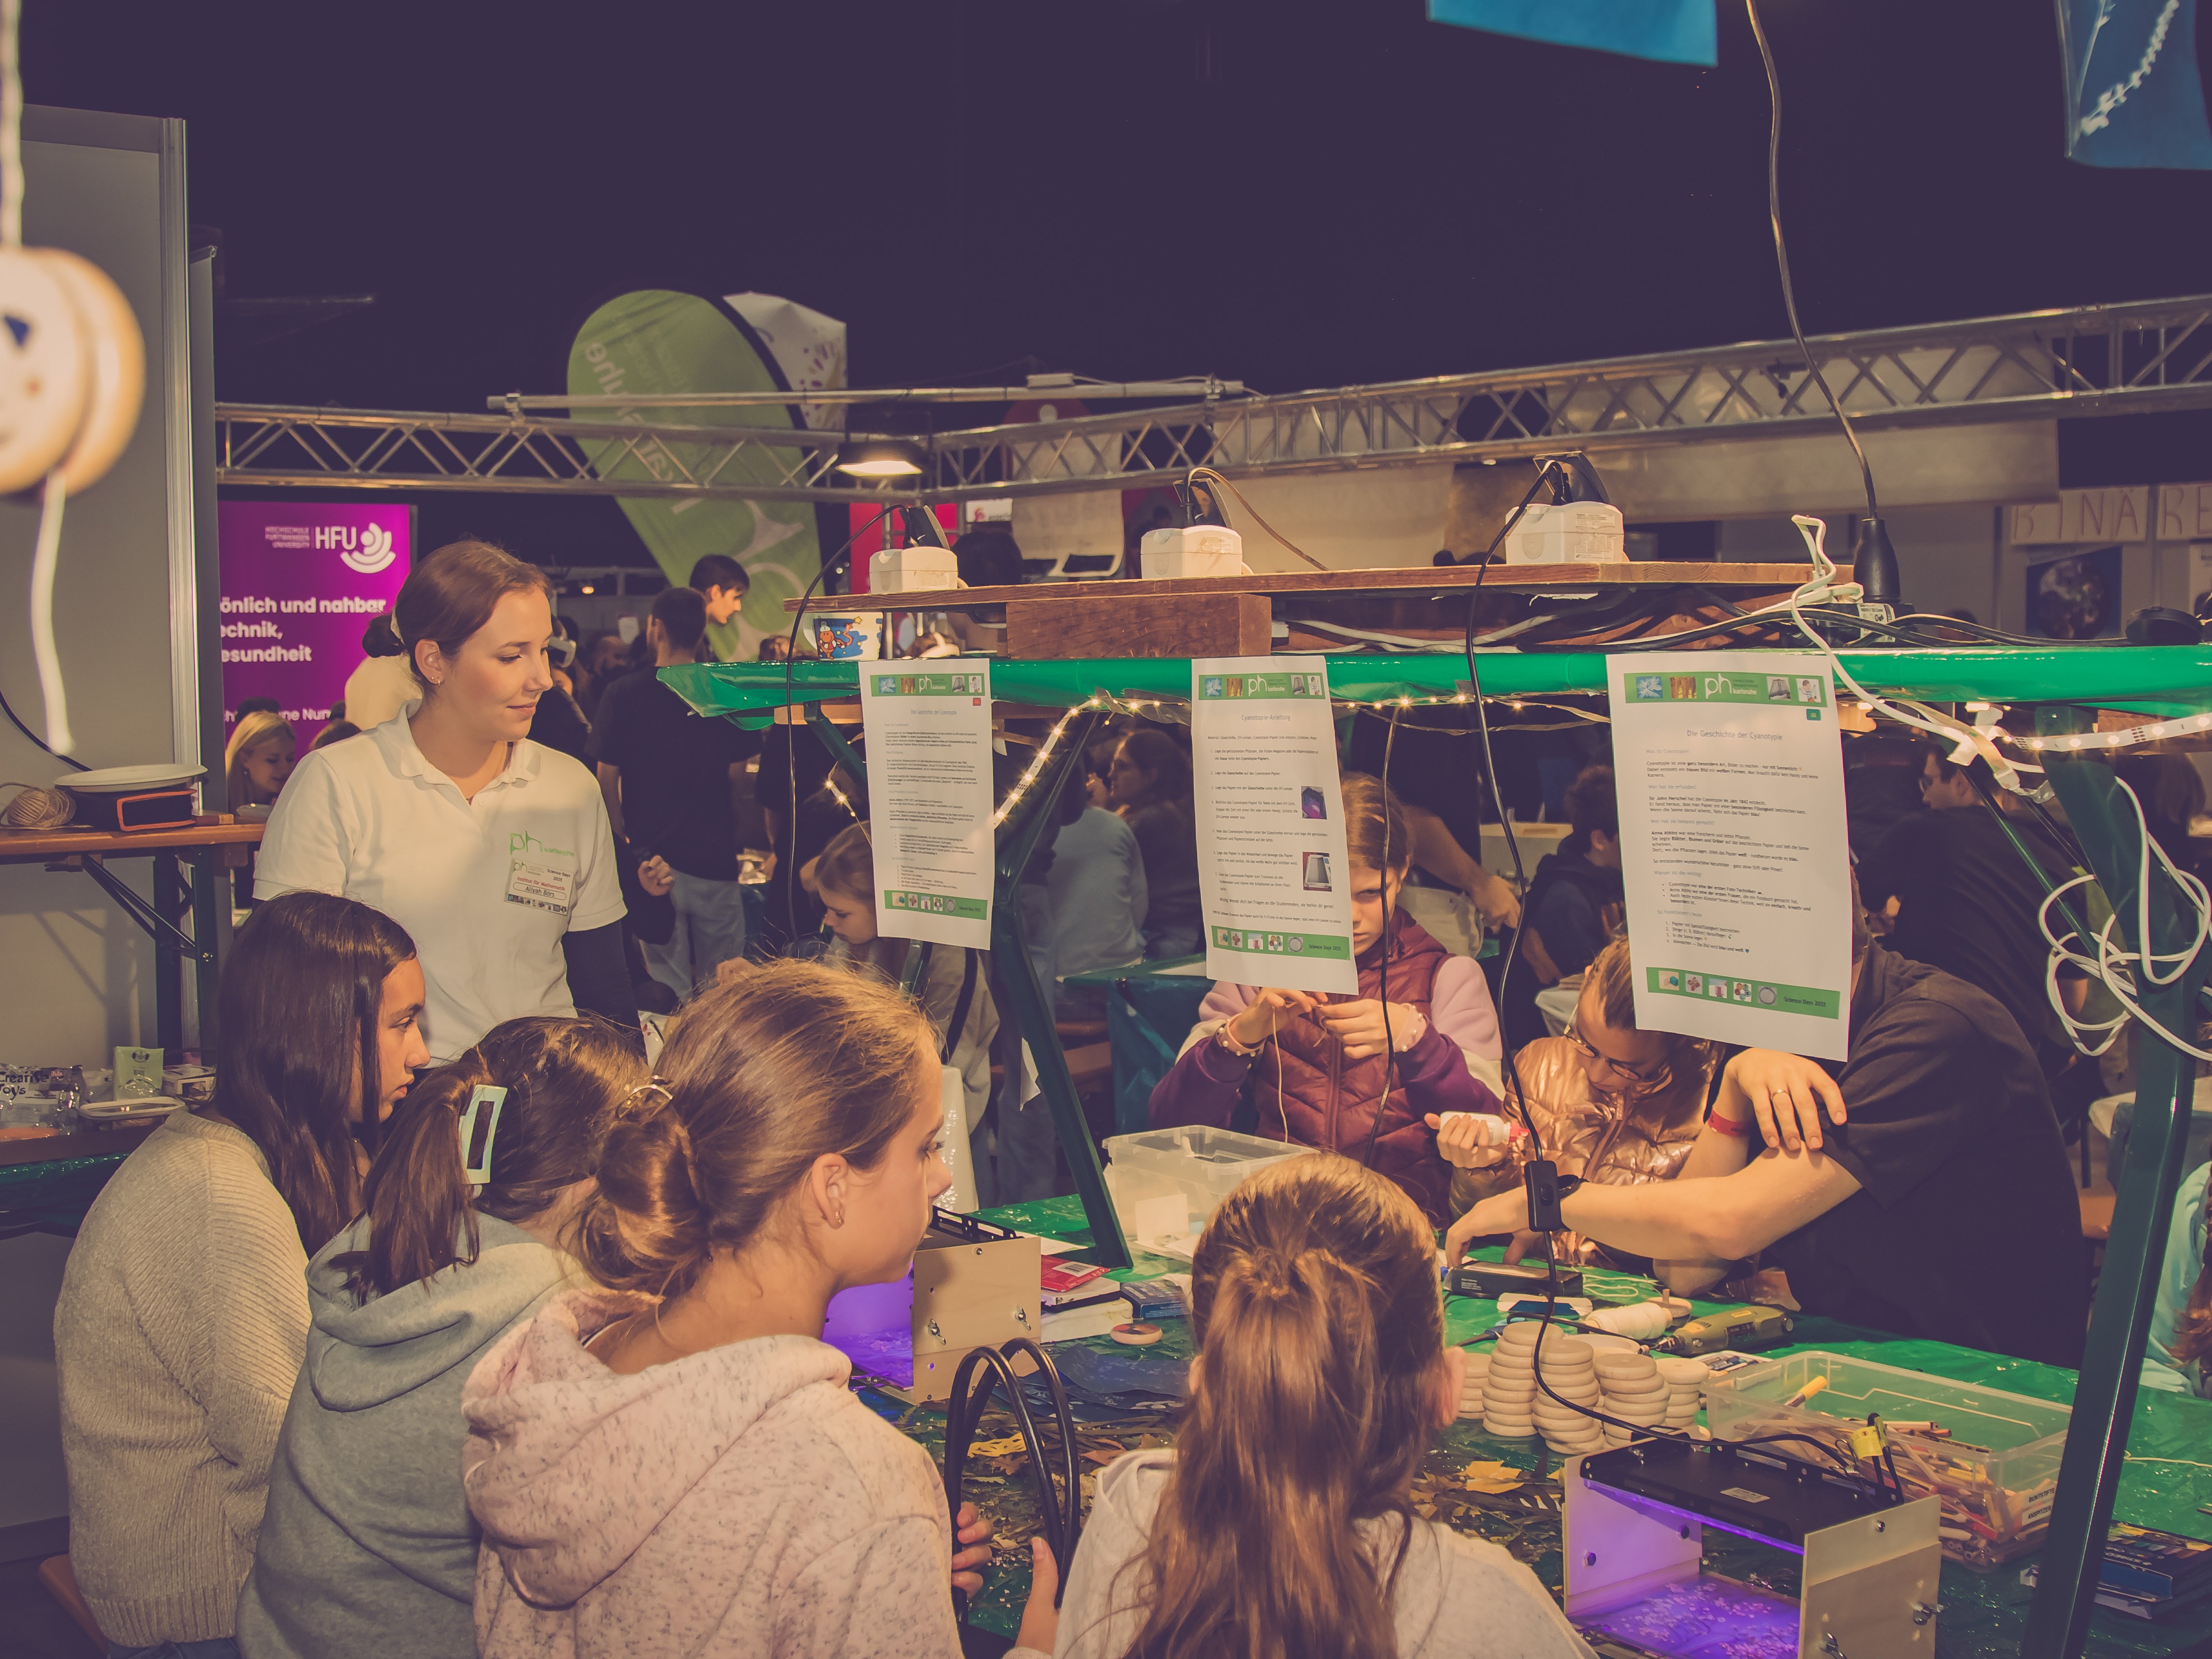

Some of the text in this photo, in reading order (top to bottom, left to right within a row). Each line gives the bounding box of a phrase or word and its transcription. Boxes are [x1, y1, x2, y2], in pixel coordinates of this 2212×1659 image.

[316, 526, 356, 549] HFU
[281, 597, 316, 613] und
[320, 596, 386, 613] nahbar
[918, 675, 932, 694] ph
[1248, 674, 1267, 697] ph
[1705, 673, 1732, 699] ph
[1750, 732, 1782, 741] Cyanotypie
[509, 830, 542, 855] ph
[513, 861, 527, 872] ph
[541, 881, 565, 891] Mathematik
[0, 1071, 49, 1083] Creative
[2029, 1488, 2055, 1503] BUNTSTIFTE
[2028, 1505, 2051, 1519] ANSPITZER
